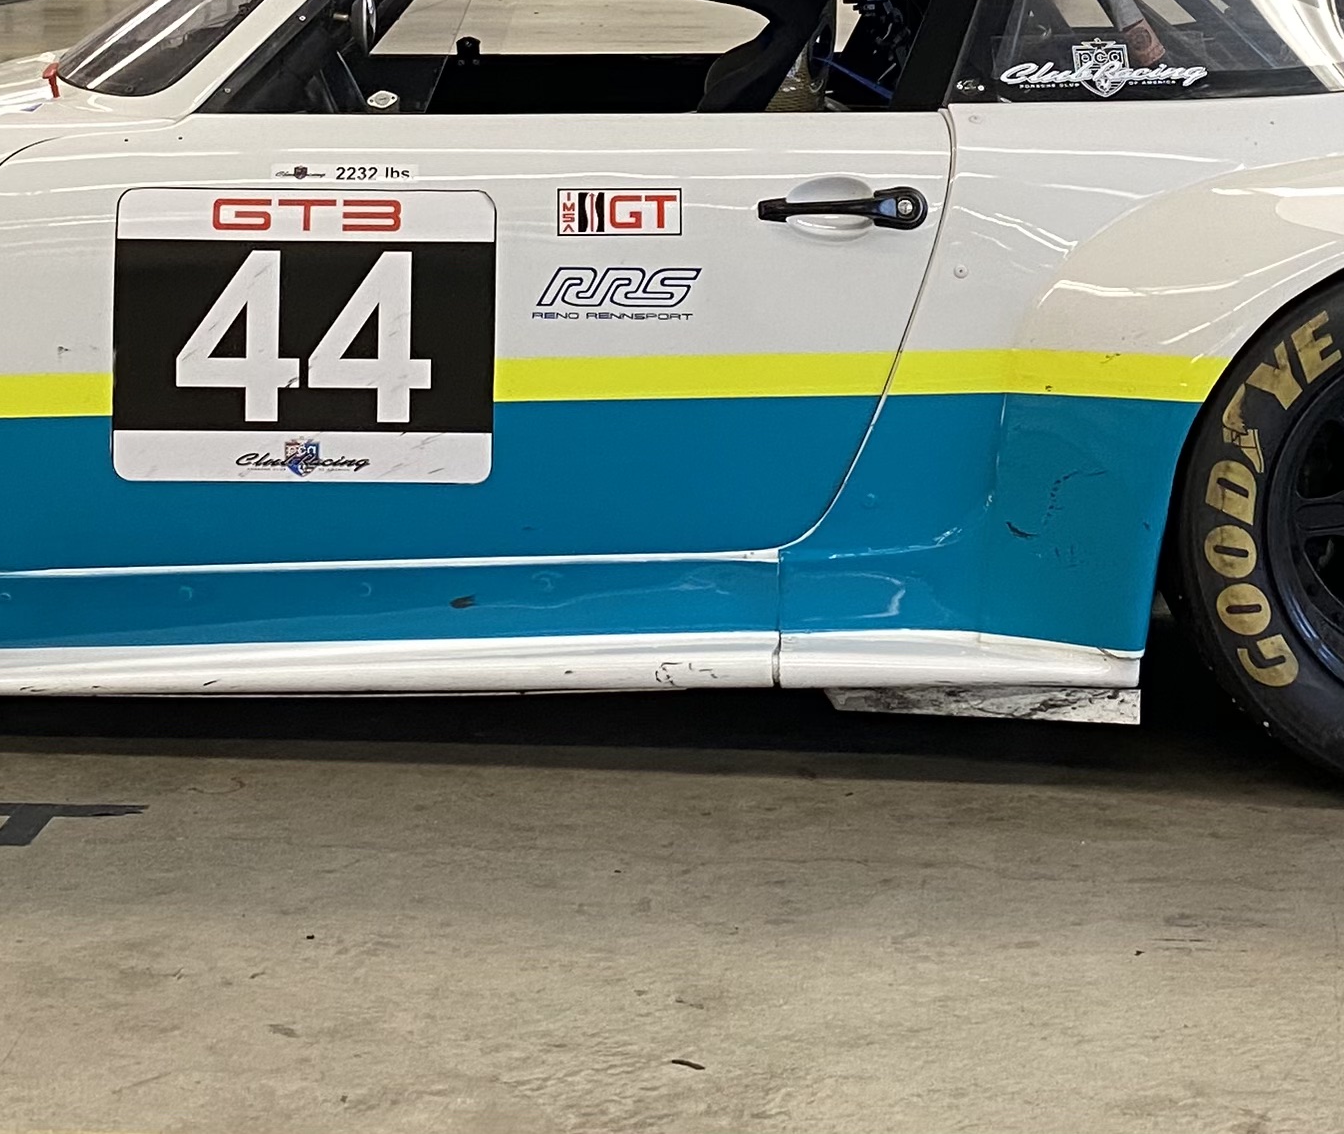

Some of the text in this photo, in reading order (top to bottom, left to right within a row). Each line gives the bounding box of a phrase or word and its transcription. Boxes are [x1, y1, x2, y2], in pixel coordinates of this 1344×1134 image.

[1000, 60, 1208, 87] Club Racing
[335, 166, 378, 181] 2232
[212, 198, 402, 233] GT3
[562, 192, 576, 233] IMSA
[609, 195, 677, 229] GT
[536, 266, 703, 308] RRS
[532, 312, 694, 321] RENO RENNSPORT
[175, 249, 432, 424] 44
[235, 452, 371, 473] Club Racing
